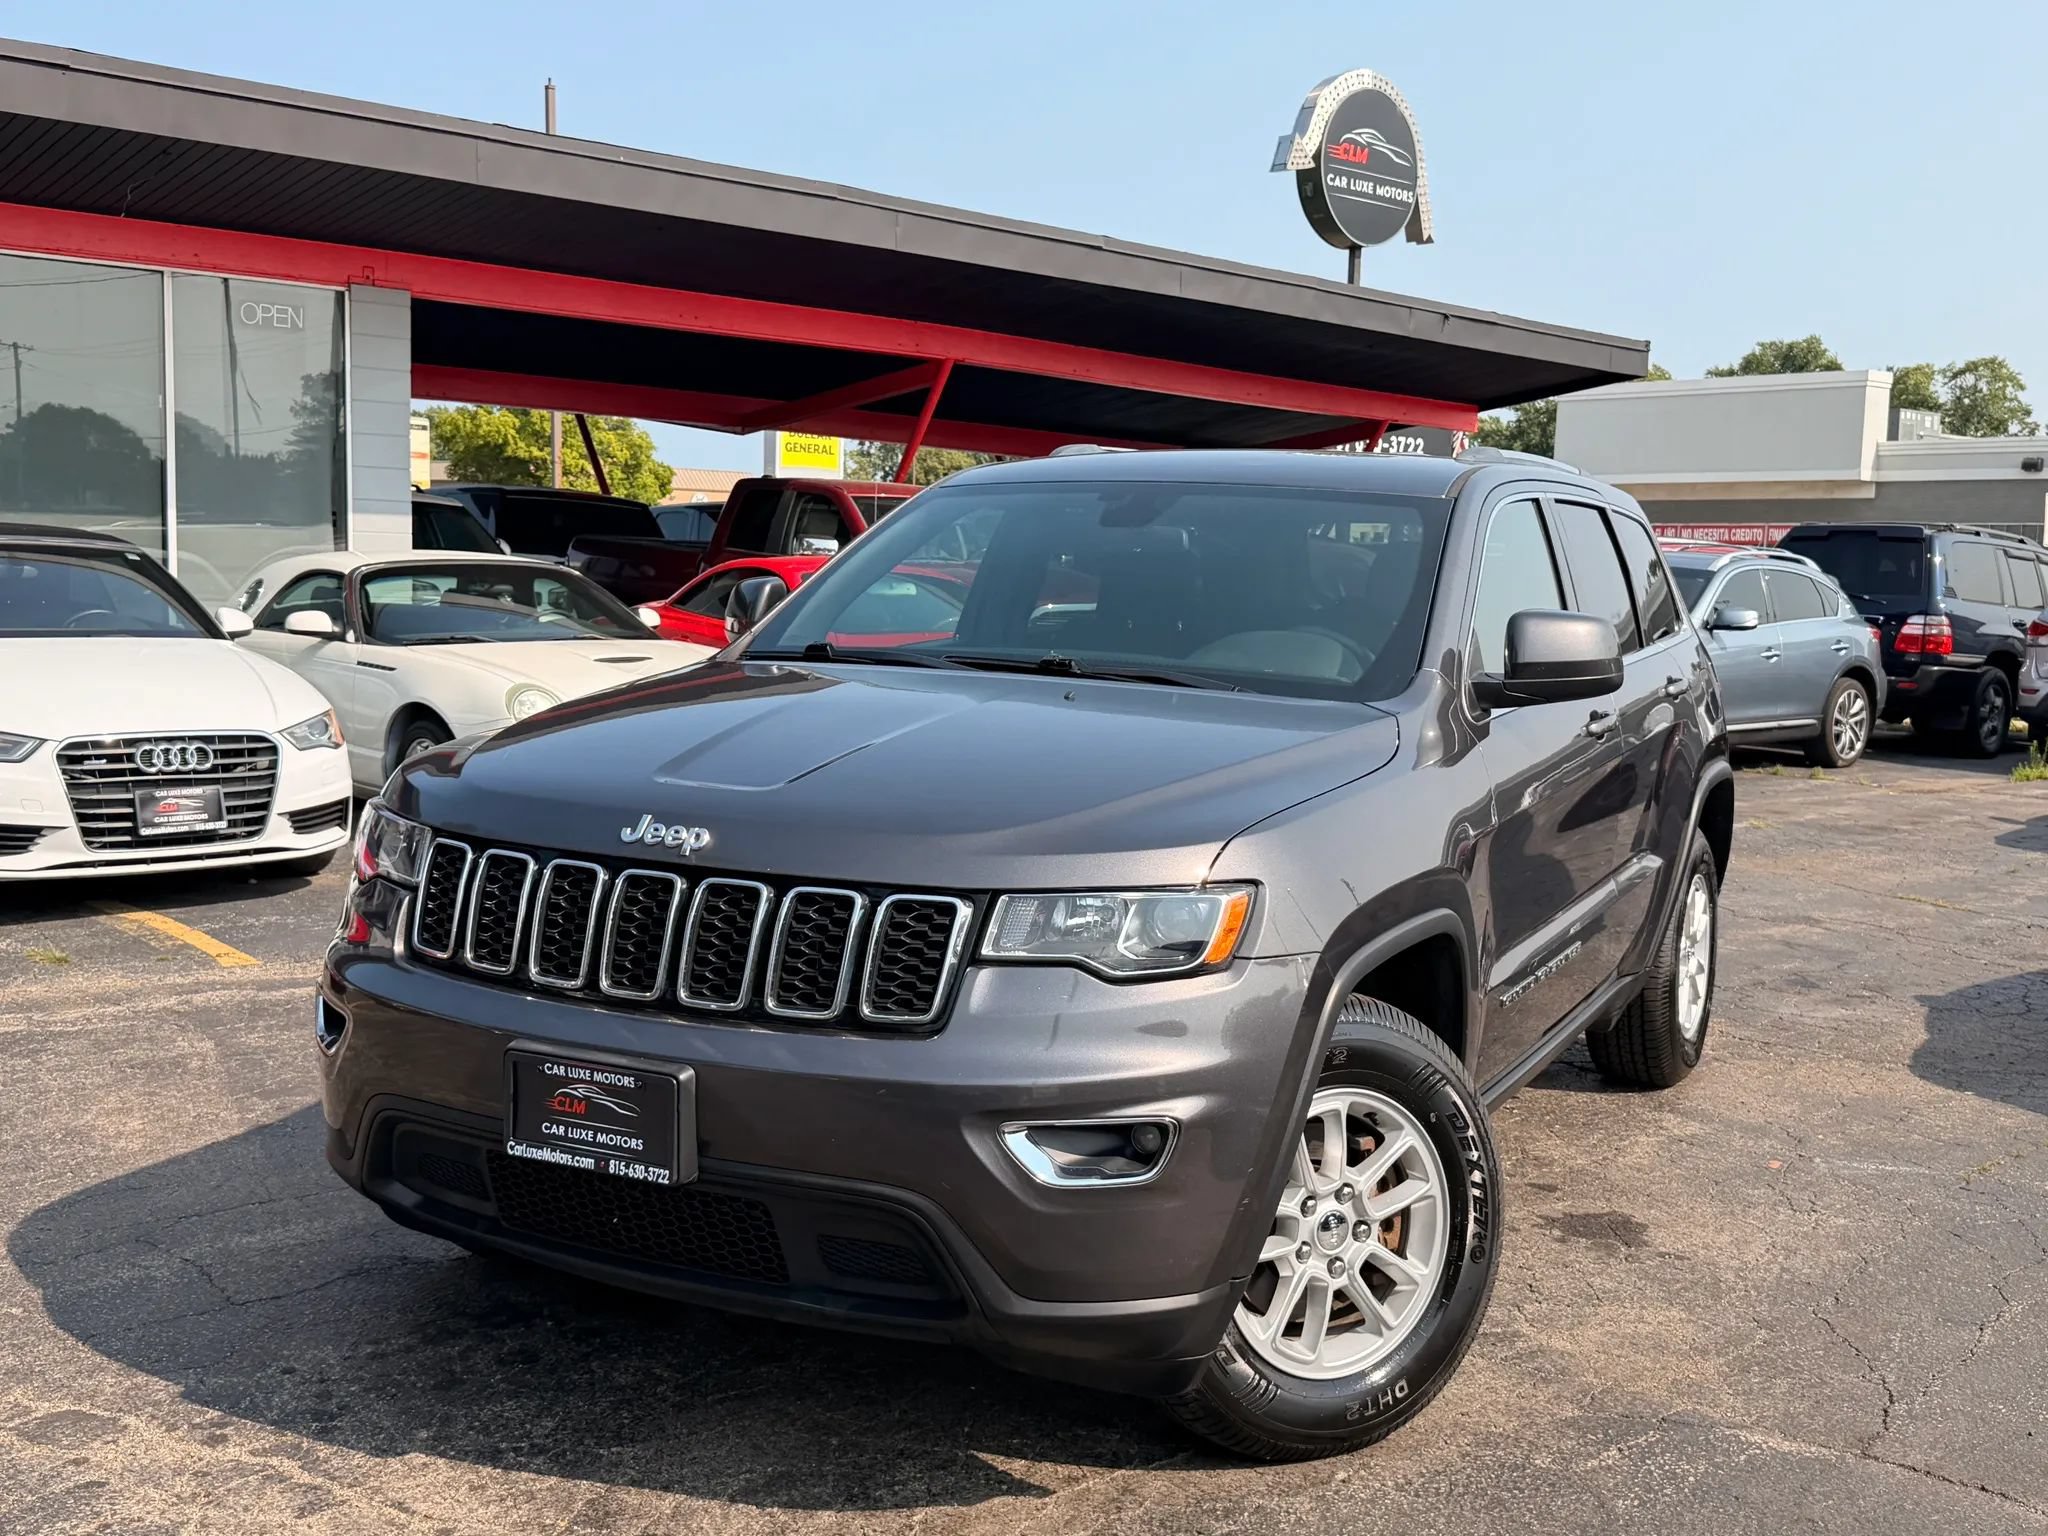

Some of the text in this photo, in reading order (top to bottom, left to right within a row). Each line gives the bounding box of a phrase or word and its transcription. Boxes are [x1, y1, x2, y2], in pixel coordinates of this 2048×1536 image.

[1339, 142, 1369, 165] CLM
[1326, 173, 1414, 203] CAR LUXE MOTORS
[240, 302, 303, 329] OPEN
[785, 442, 835, 455] GENERAL
[1681, 527, 1763, 541] NO NECESITA CREDITO
[620, 813, 711, 857] Jeep
[543, 1062, 635, 1088] CAR LUXE MOTORS
[553, 1096, 586, 1115] CLM
[542, 1122, 643, 1151] CAR LUXE MOTORS
[507, 1140, 670, 1185] CarLuxeMotors.com 815-630-3722
